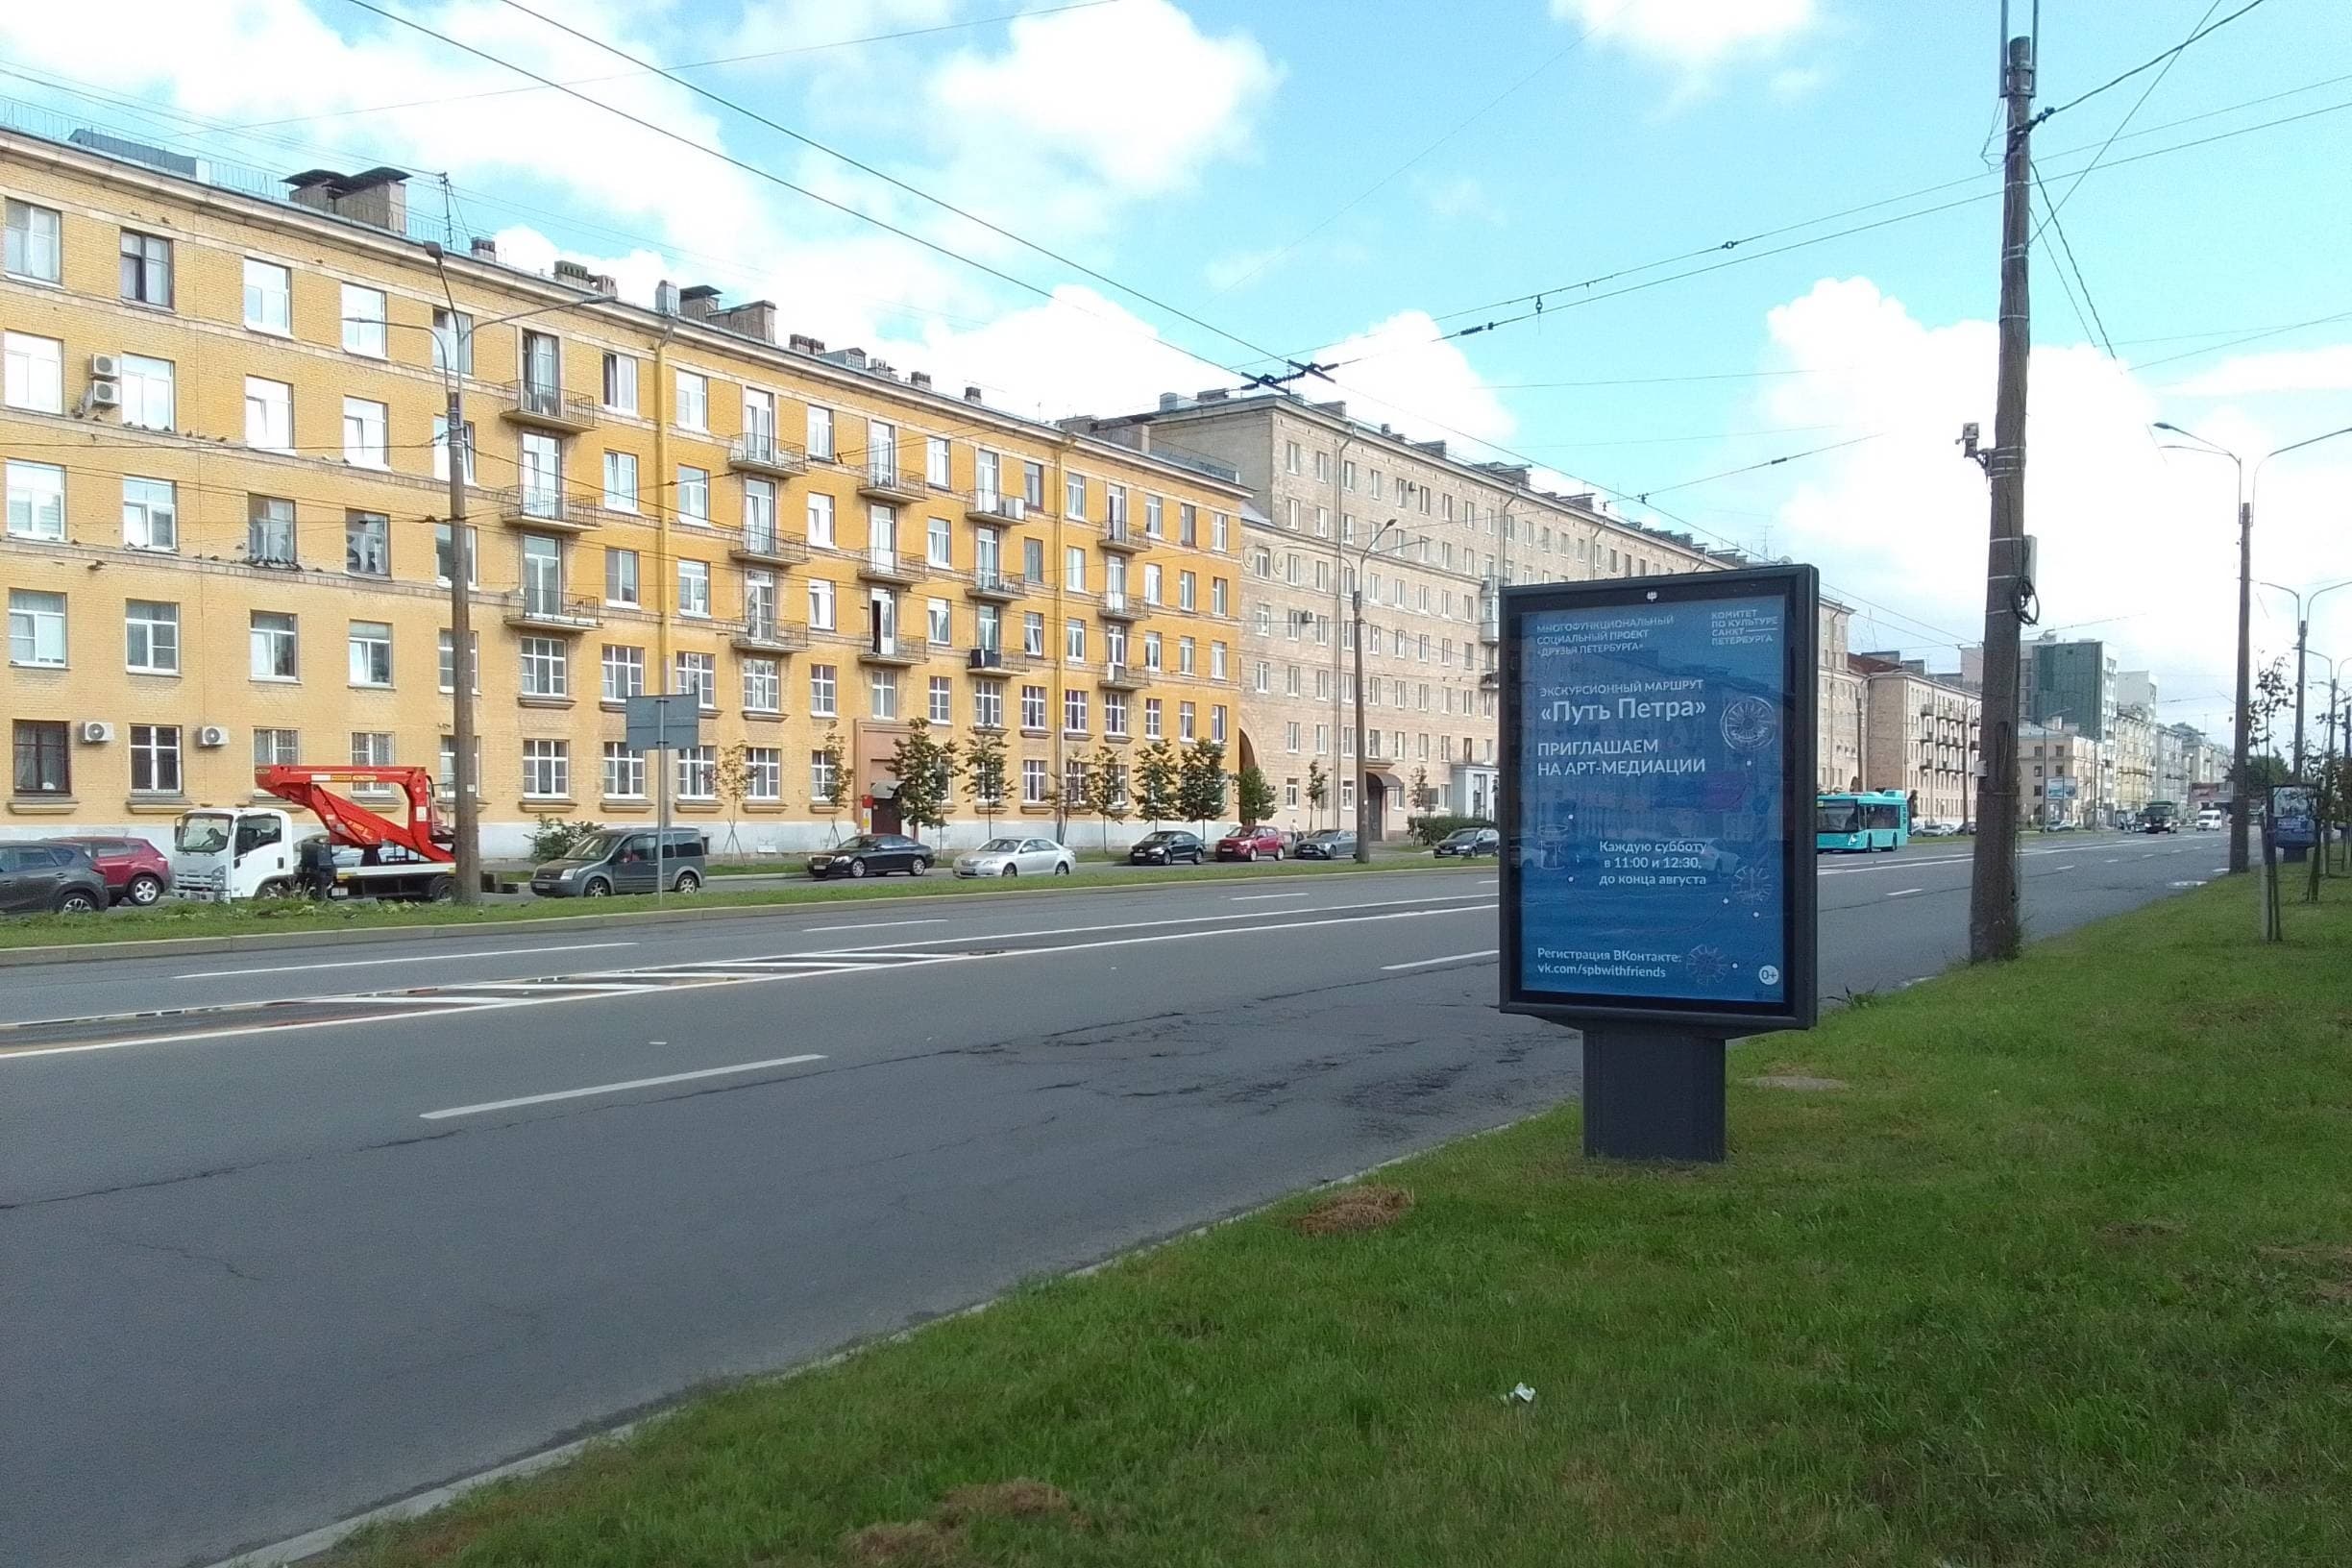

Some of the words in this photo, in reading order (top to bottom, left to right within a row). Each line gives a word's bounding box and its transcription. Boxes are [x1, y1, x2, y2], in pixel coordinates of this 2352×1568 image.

[1711, 609, 1758, 620] КОМИТЕТ
[1711, 620, 1727, 628] ПО
[1727, 616, 1778, 627] КУЛЬТУРЕ
[1536, 615, 1675, 633] МНОГОФУНКЦИОНАЛЬНЫЙ
[1536, 630, 1608, 646] СОЦИАЛЬНЫЙ
[1609, 629, 1650, 641] ПРОЕКТ
[1711, 634, 1774, 647] ПЕТЕРБУРГА
[1539, 681, 1642, 698] ЭКСКУРСИОННЫЙ
[1644, 679, 1703, 693] МАРШРУТ
[1540, 699, 1611, 725] «Путь
[1618, 698, 1706, 722] Петра»
[1537, 739, 1658, 757] ПРИГЛАШАЕМ
[1537, 762, 1561, 776] НА
[1564, 757, 1706, 777] АРТ-МЕДИАЦИИ
[1599, 840, 1653, 854] Каждую
[1654, 841, 1707, 855] субботу
[1604, 859, 1611, 869] в
[1614, 856, 1649, 869] 11:00
[1652, 860, 1659, 869] и
[1662, 856, 1703, 870] 12:30,
[1599, 875, 1616, 887] до
[1618, 875, 1655, 887] конца
[1658, 875, 1707, 888] августа
[1537, 947, 1610, 961] Регистрация
[1613, 949, 1682, 963] ВКонтакте:
[1537, 963, 1667, 978] vk.com/spbwithfriends
[1761, 969, 1777, 980] 0+
